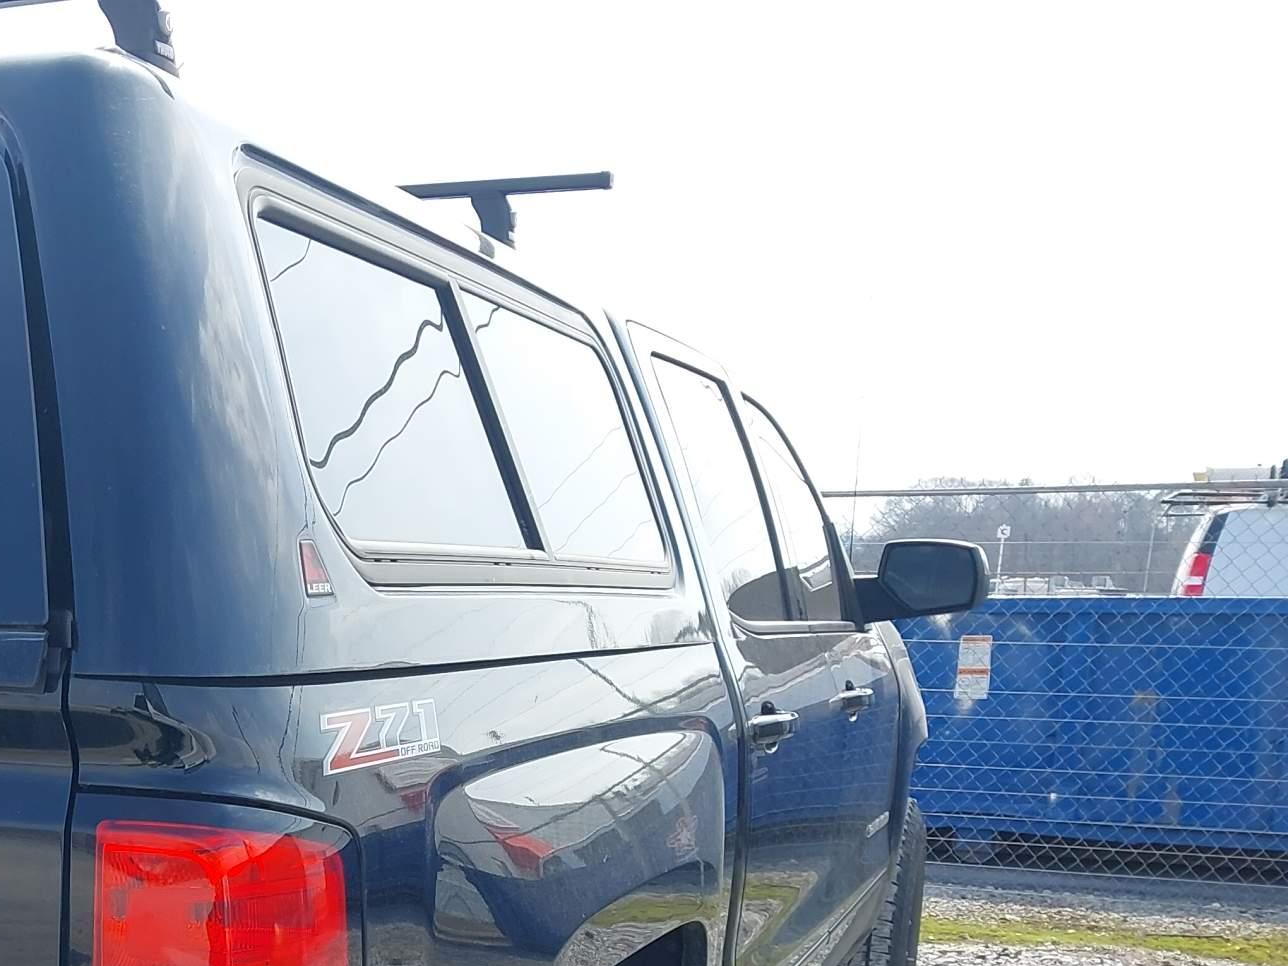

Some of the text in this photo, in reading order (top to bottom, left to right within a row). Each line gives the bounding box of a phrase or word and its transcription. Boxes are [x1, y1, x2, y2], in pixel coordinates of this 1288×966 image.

[307, 582, 332, 593] LEER
[319, 698, 440, 776] Z71
[400, 741, 440, 757] OFF ROAD
